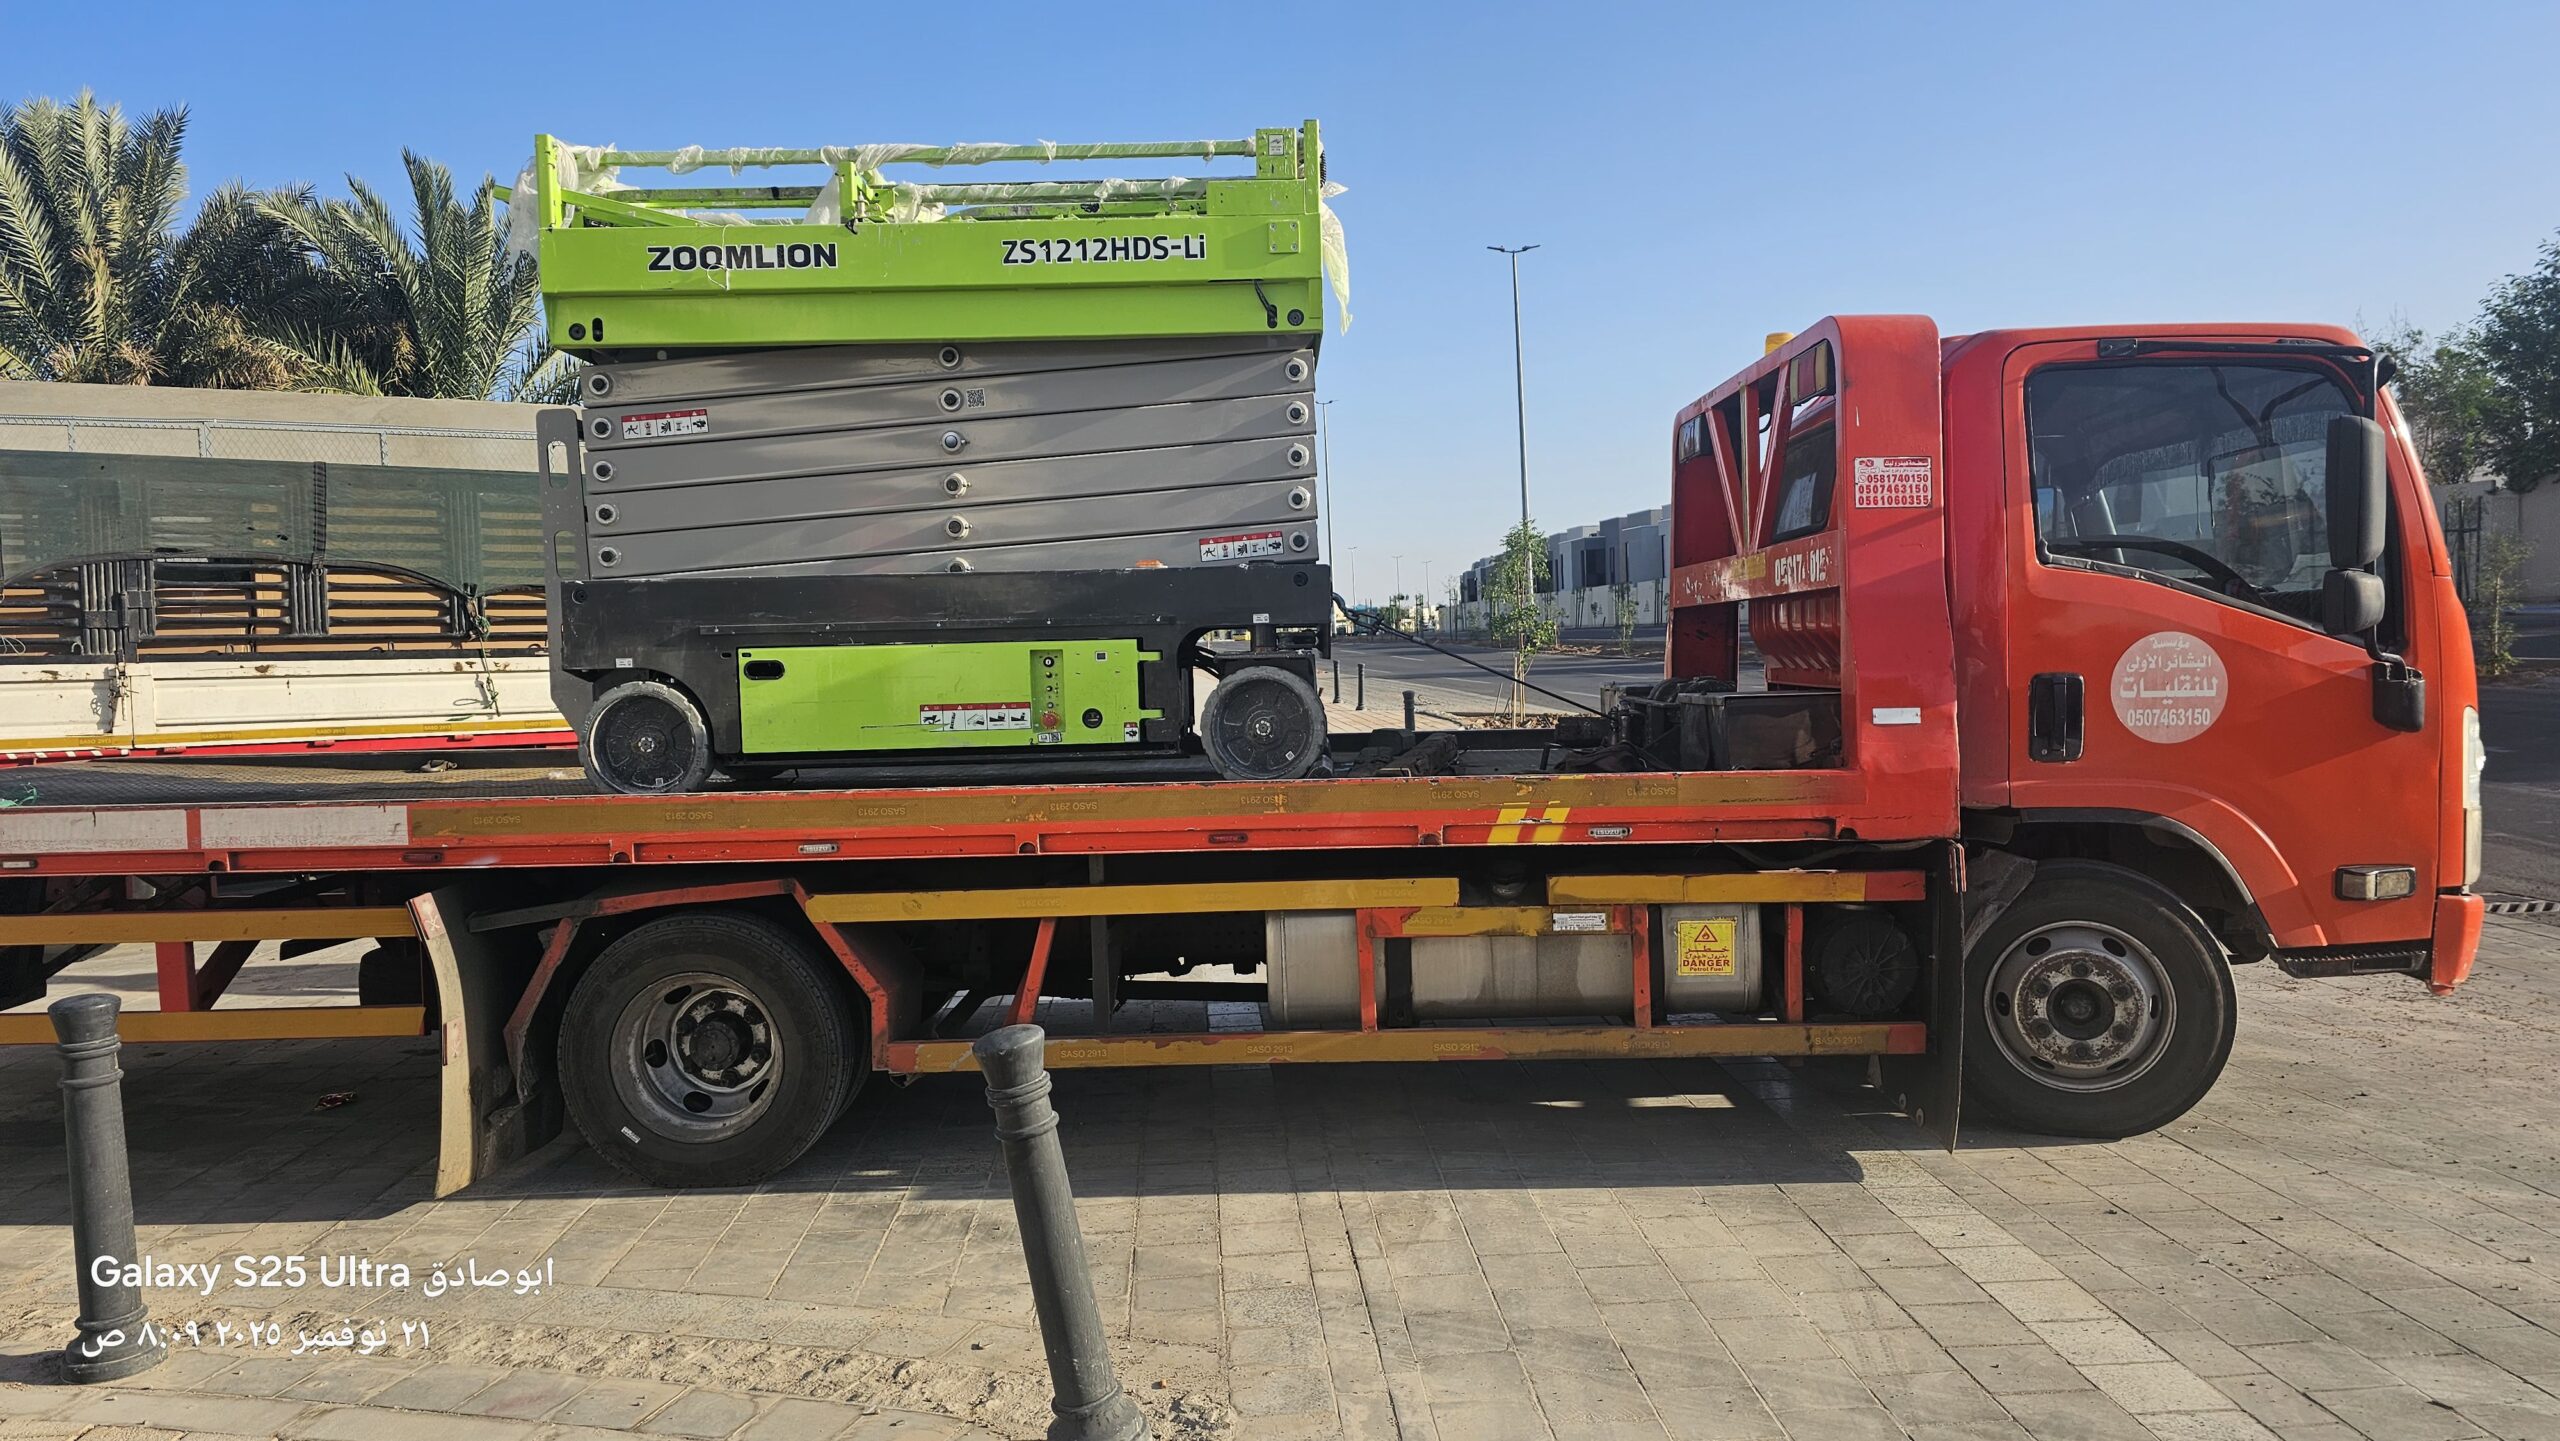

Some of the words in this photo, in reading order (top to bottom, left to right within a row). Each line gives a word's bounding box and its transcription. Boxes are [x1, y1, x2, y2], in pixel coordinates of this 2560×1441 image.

[1001, 234, 1206, 264] ZS1212HDS-Li
[647, 243, 838, 271] ZOOMLION
[1867, 474, 1929, 483] 0581740150
[1858, 484, 1929, 494] 0507463150
[1858, 495, 1929, 506] 0561060355
[2150, 636, 2191, 651] مؤسسة
[2126, 654, 2162, 673] الأولى
[2163, 652, 2212, 672] البشائر
[2120, 674, 2219, 705] للنقليات
[2127, 707, 2211, 727] 0507463150
[1431, 791, 1453, 800] 2913
[1454, 790, 1480, 799] SASO
[1651, 787, 1677, 796] SASO
[1240, 796, 1261, 805] 2913
[1049, 802, 1071, 811] 2913
[1072, 801, 1098, 810] SASO
[665, 811, 688, 820] 2913
[688, 811, 713, 820] SASO
[857, 807, 879, 816] 2913
[880, 807, 906, 816] SASO
[473, 816, 494, 825] 2913
[495, 815, 521, 824] SASO
[1682, 959, 1730, 967] DANGER
[1246, 1045, 1272, 1054] SASO
[1272, 1045, 1294, 1054] 2913
[1433, 1043, 1458, 1052] SASO
[1060, 1049, 1086, 1058] SASO
[1087, 1048, 1107, 1057] 2913
